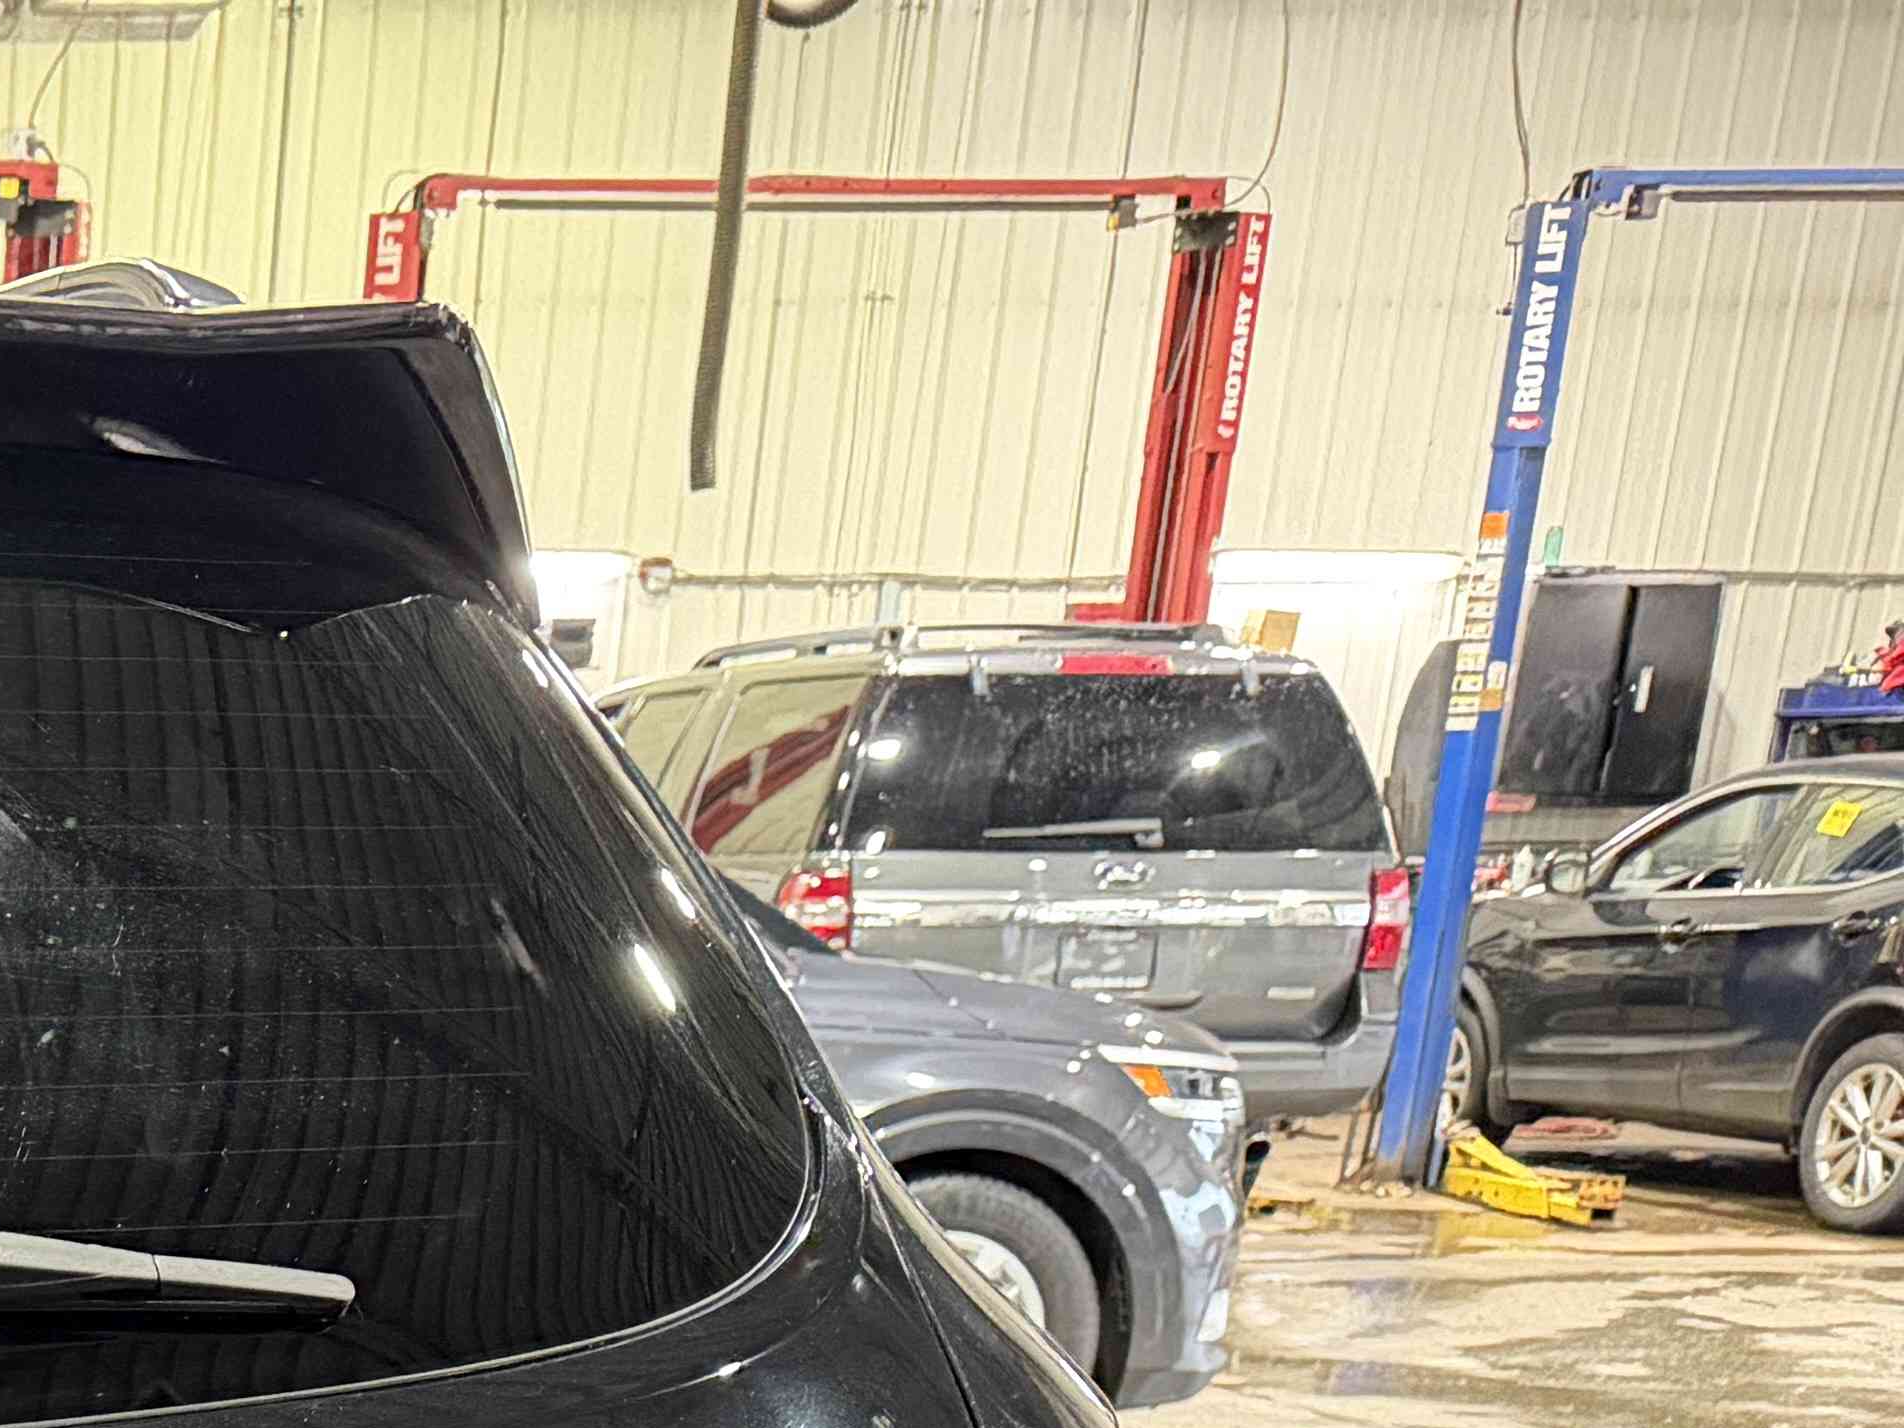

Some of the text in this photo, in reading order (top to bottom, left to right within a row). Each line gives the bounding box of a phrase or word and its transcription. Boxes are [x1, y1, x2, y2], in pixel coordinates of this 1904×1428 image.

[373, 217, 406, 286] LIFT
[1220, 215, 1265, 421] ROTARY LIFT
[1512, 203, 1571, 413] ROTARY LIFT
